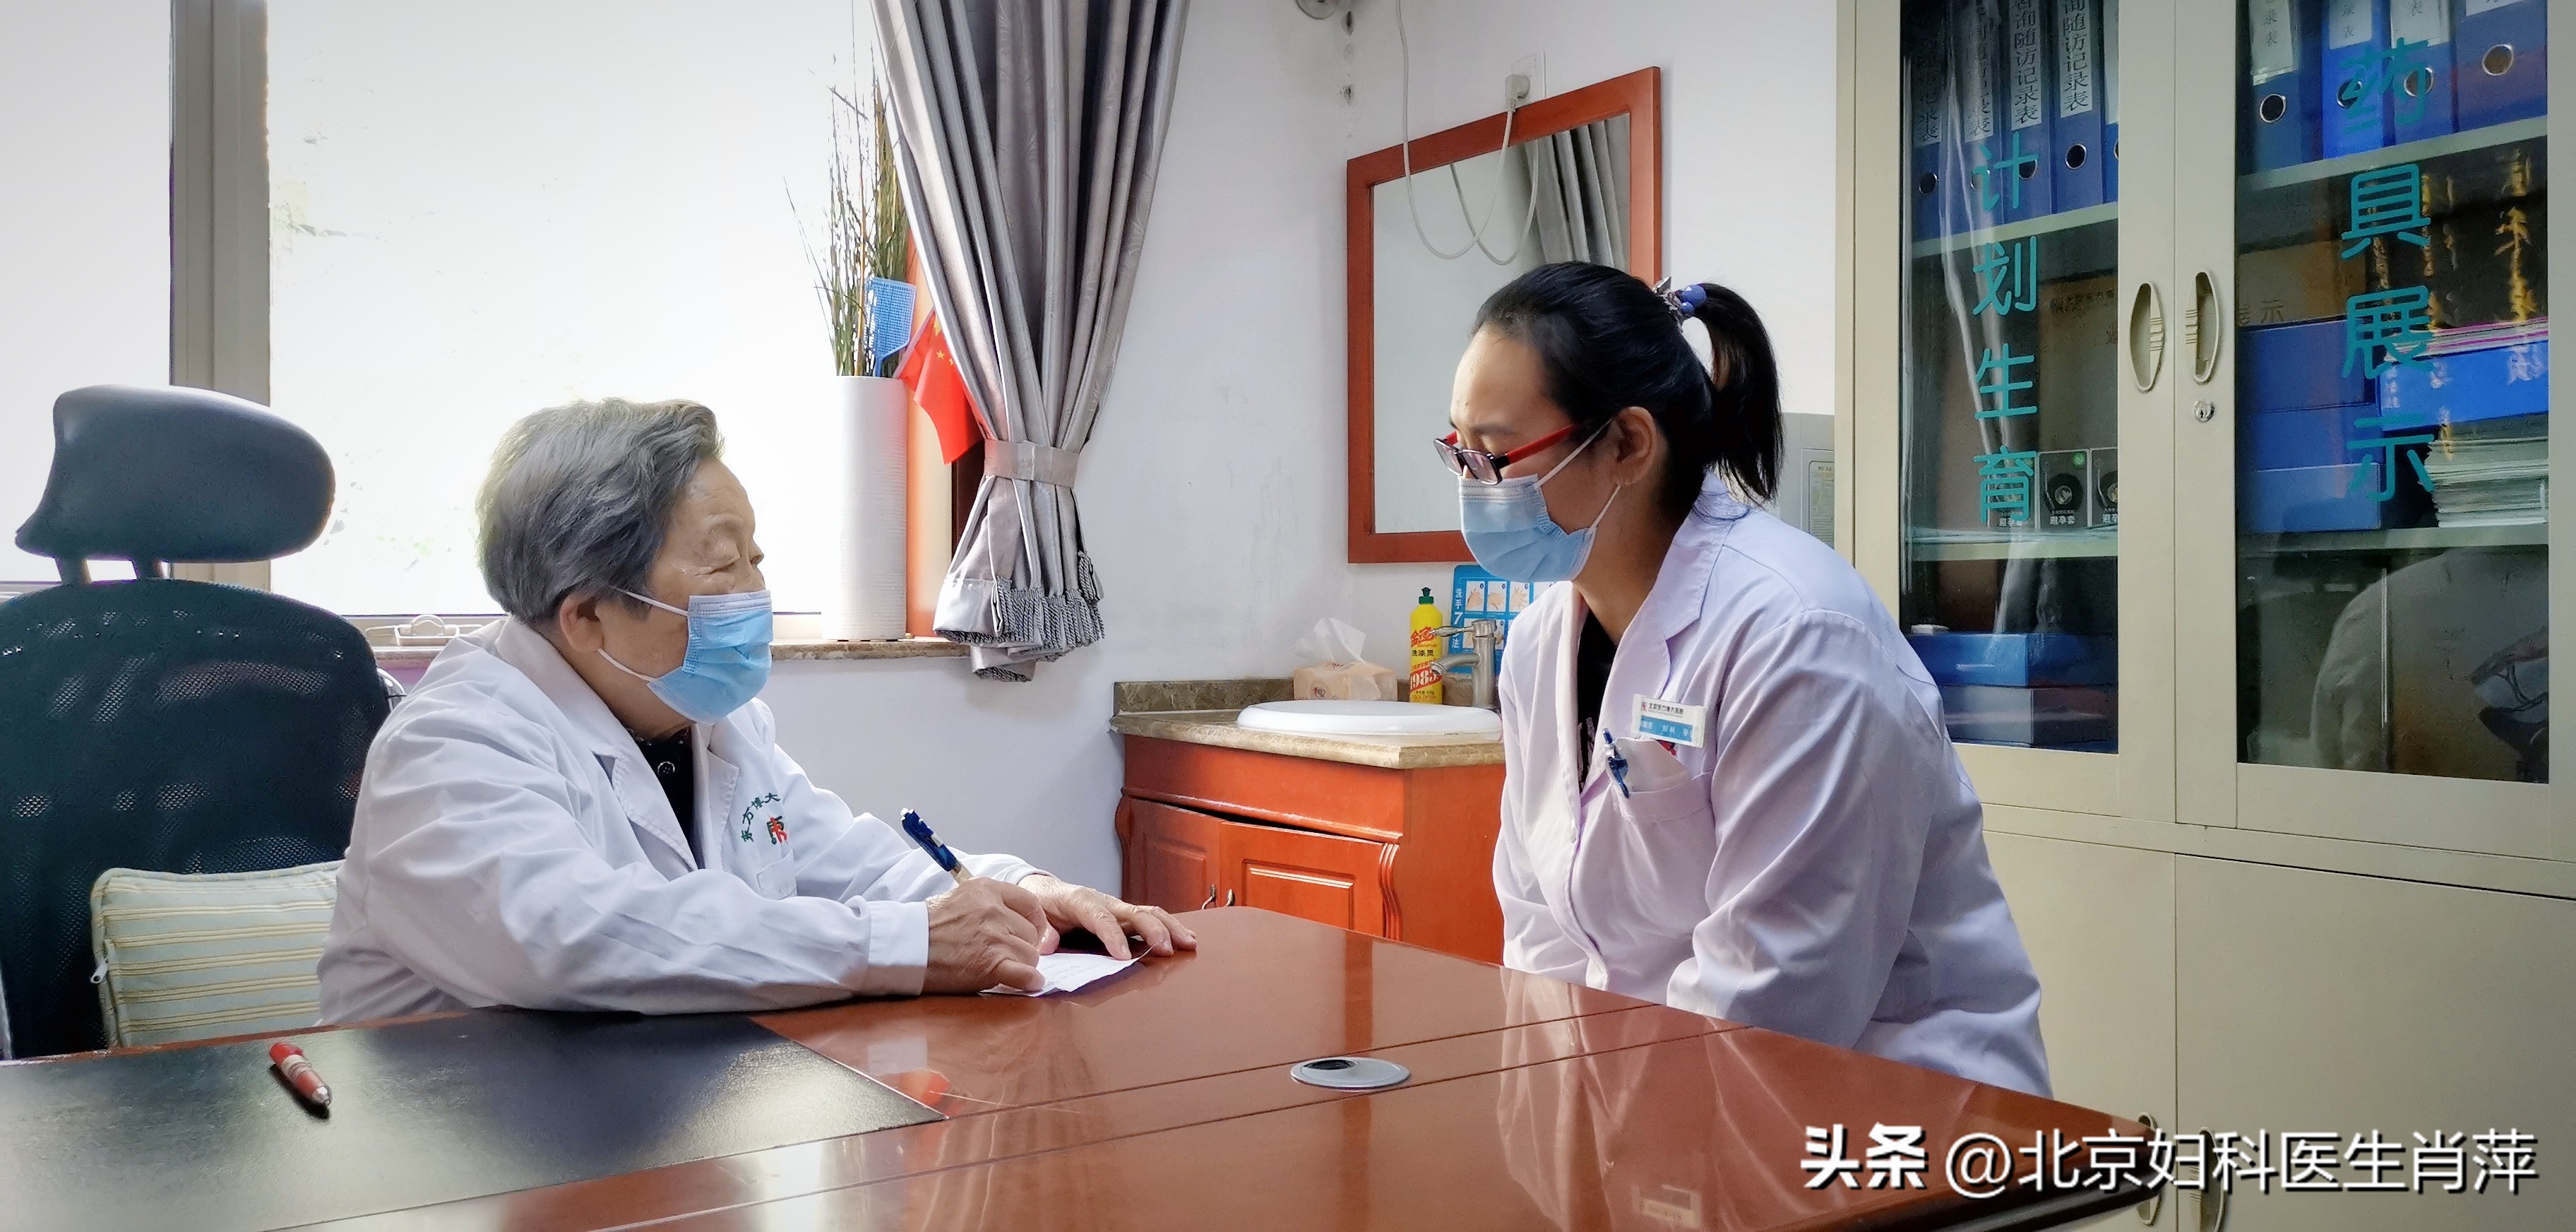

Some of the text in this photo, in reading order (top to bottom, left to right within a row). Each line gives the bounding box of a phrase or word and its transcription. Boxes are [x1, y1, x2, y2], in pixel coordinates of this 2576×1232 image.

[1972, 131, 2039, 523] 计划生育
[2339, 37, 2435, 502] 药具展示
[1451, 587, 1464, 649] 洗手7法
